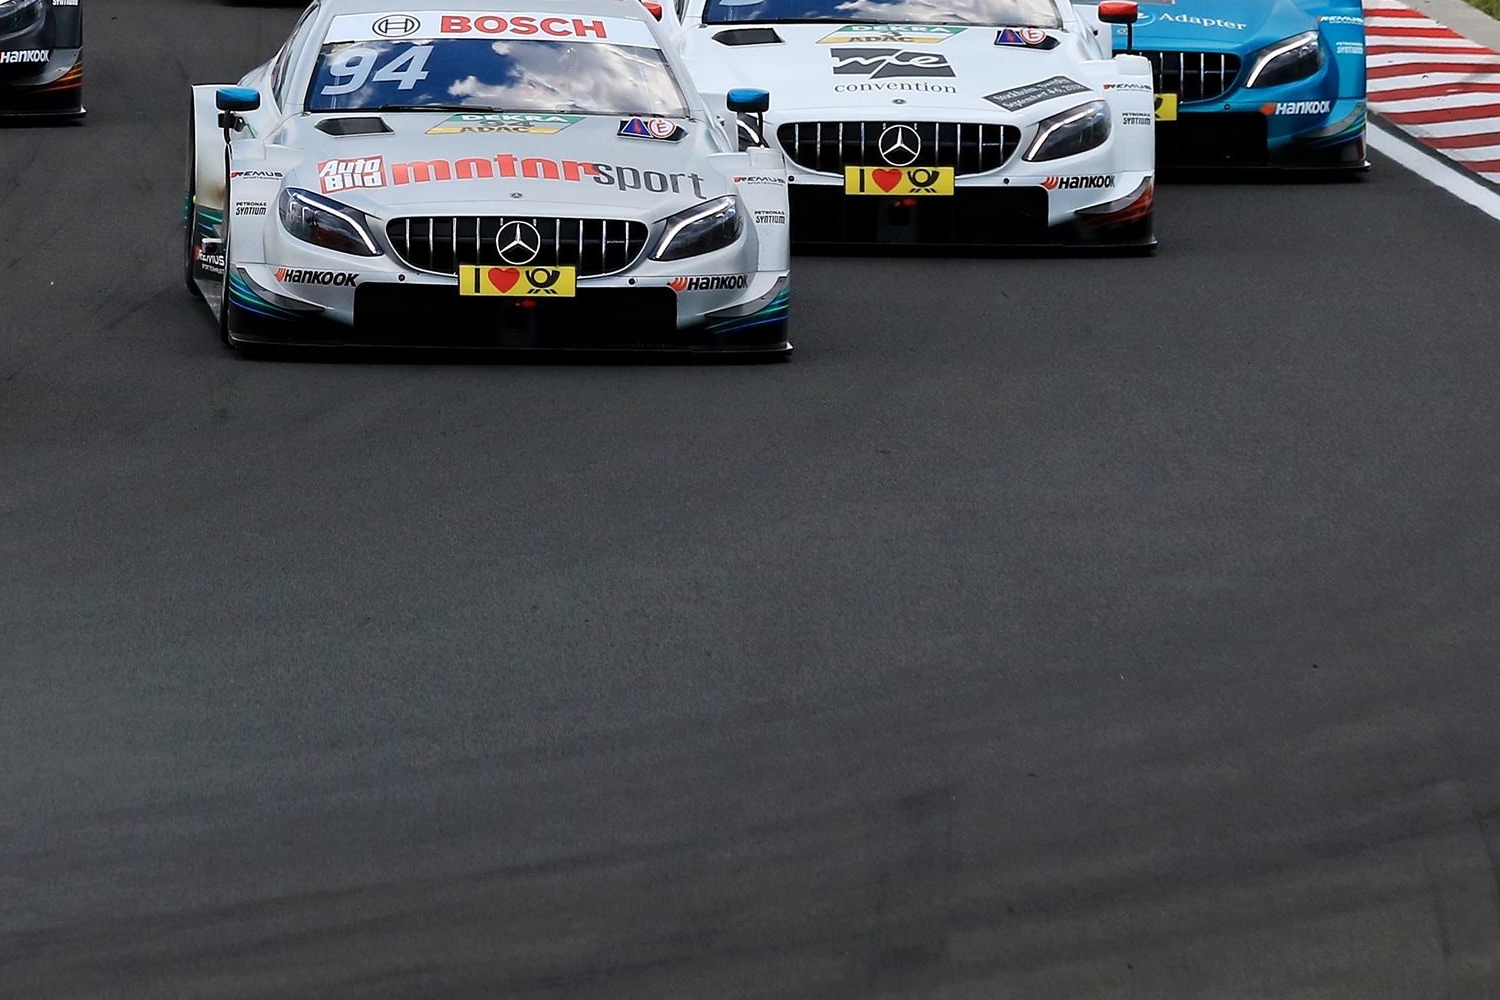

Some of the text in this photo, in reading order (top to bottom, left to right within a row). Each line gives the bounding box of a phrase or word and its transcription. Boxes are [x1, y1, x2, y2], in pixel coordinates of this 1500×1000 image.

[439, 14, 608, 39] BOSCH
[1158, 12, 1247, 32] Adapter
[850, 25, 947, 34] DEKRA
[320, 44, 435, 96] 94
[834, 81, 958, 95] convention
[461, 114, 568, 123] DEKRA
[459, 126, 530, 134] ADAC
[234, 170, 284, 178] REMUS
[318, 157, 383, 179] Auto
[324, 171, 384, 191] Bild
[235, 206, 267, 216] SYNTIUM
[755, 215, 786, 225] SYNTIUM
